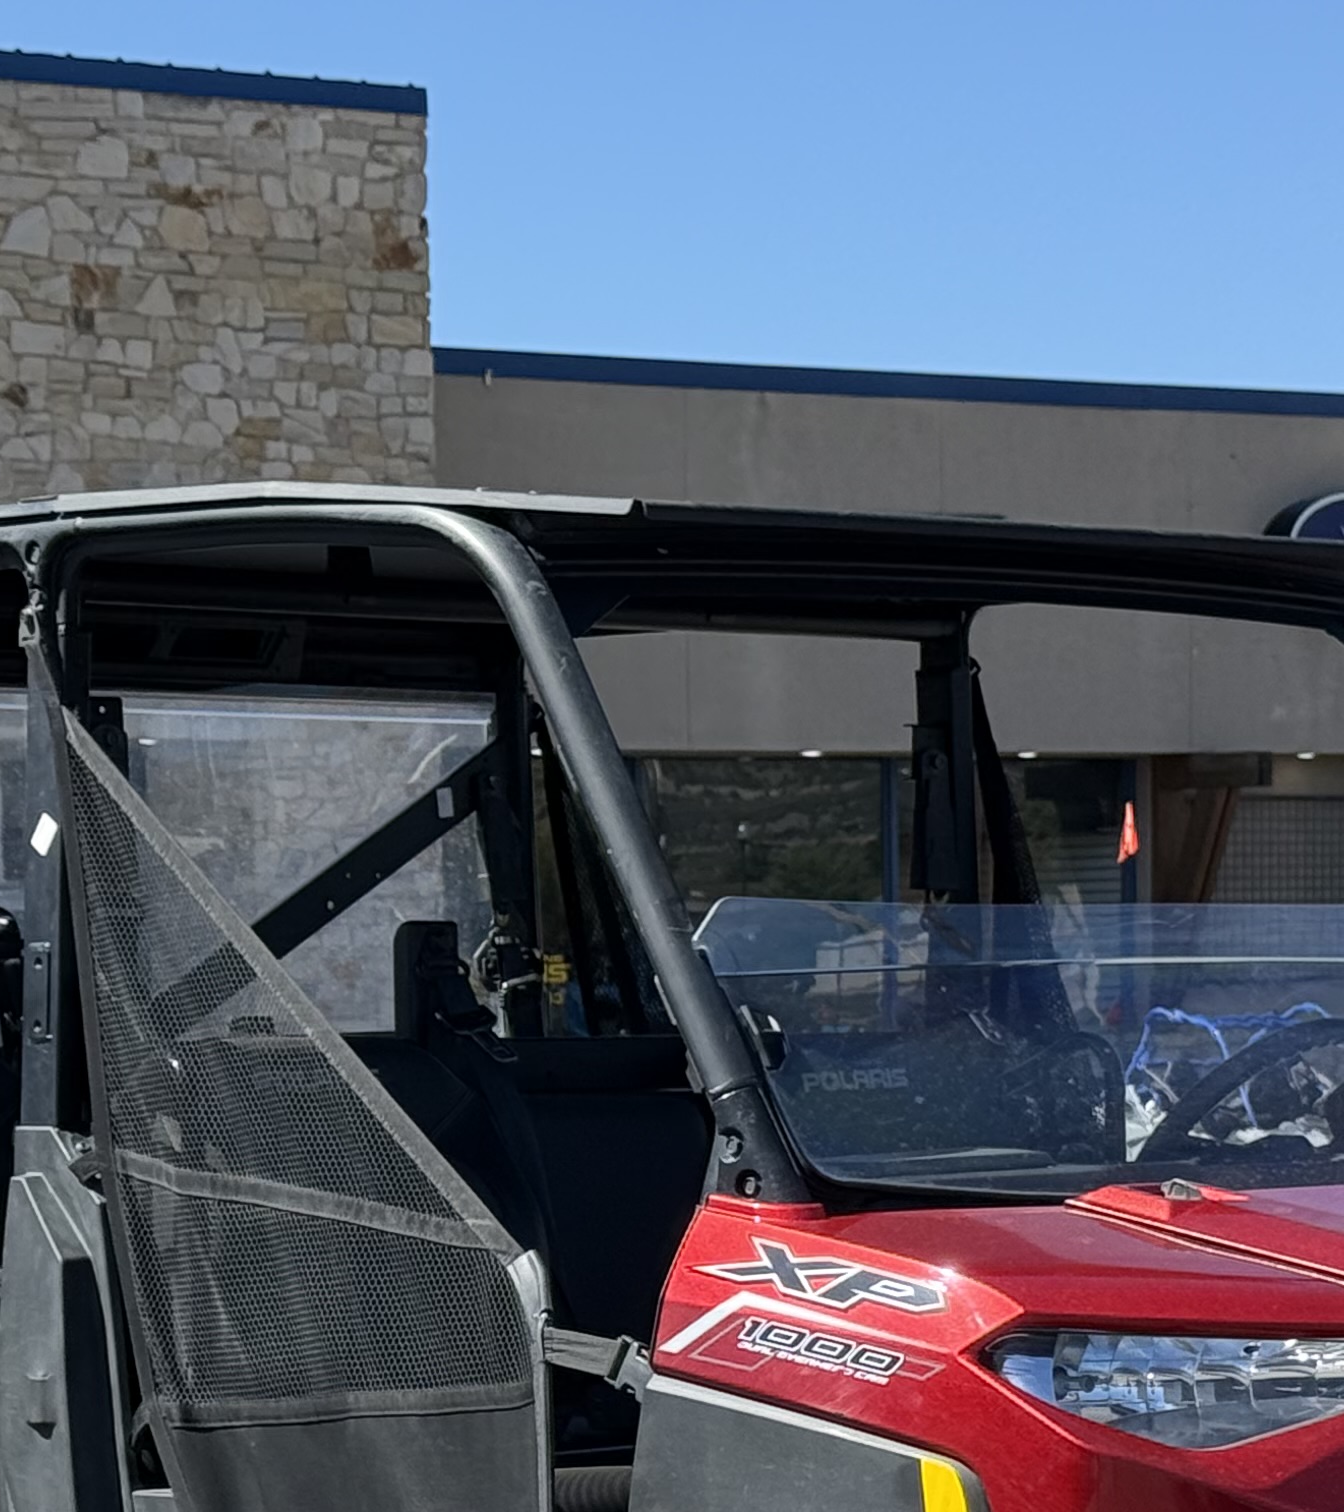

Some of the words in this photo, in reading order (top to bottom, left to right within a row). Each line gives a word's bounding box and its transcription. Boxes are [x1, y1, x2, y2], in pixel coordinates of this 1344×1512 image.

[801, 1067, 909, 1093] POLARIS
[686, 1234, 948, 1312] XP
[738, 1315, 905, 1376] 1000
